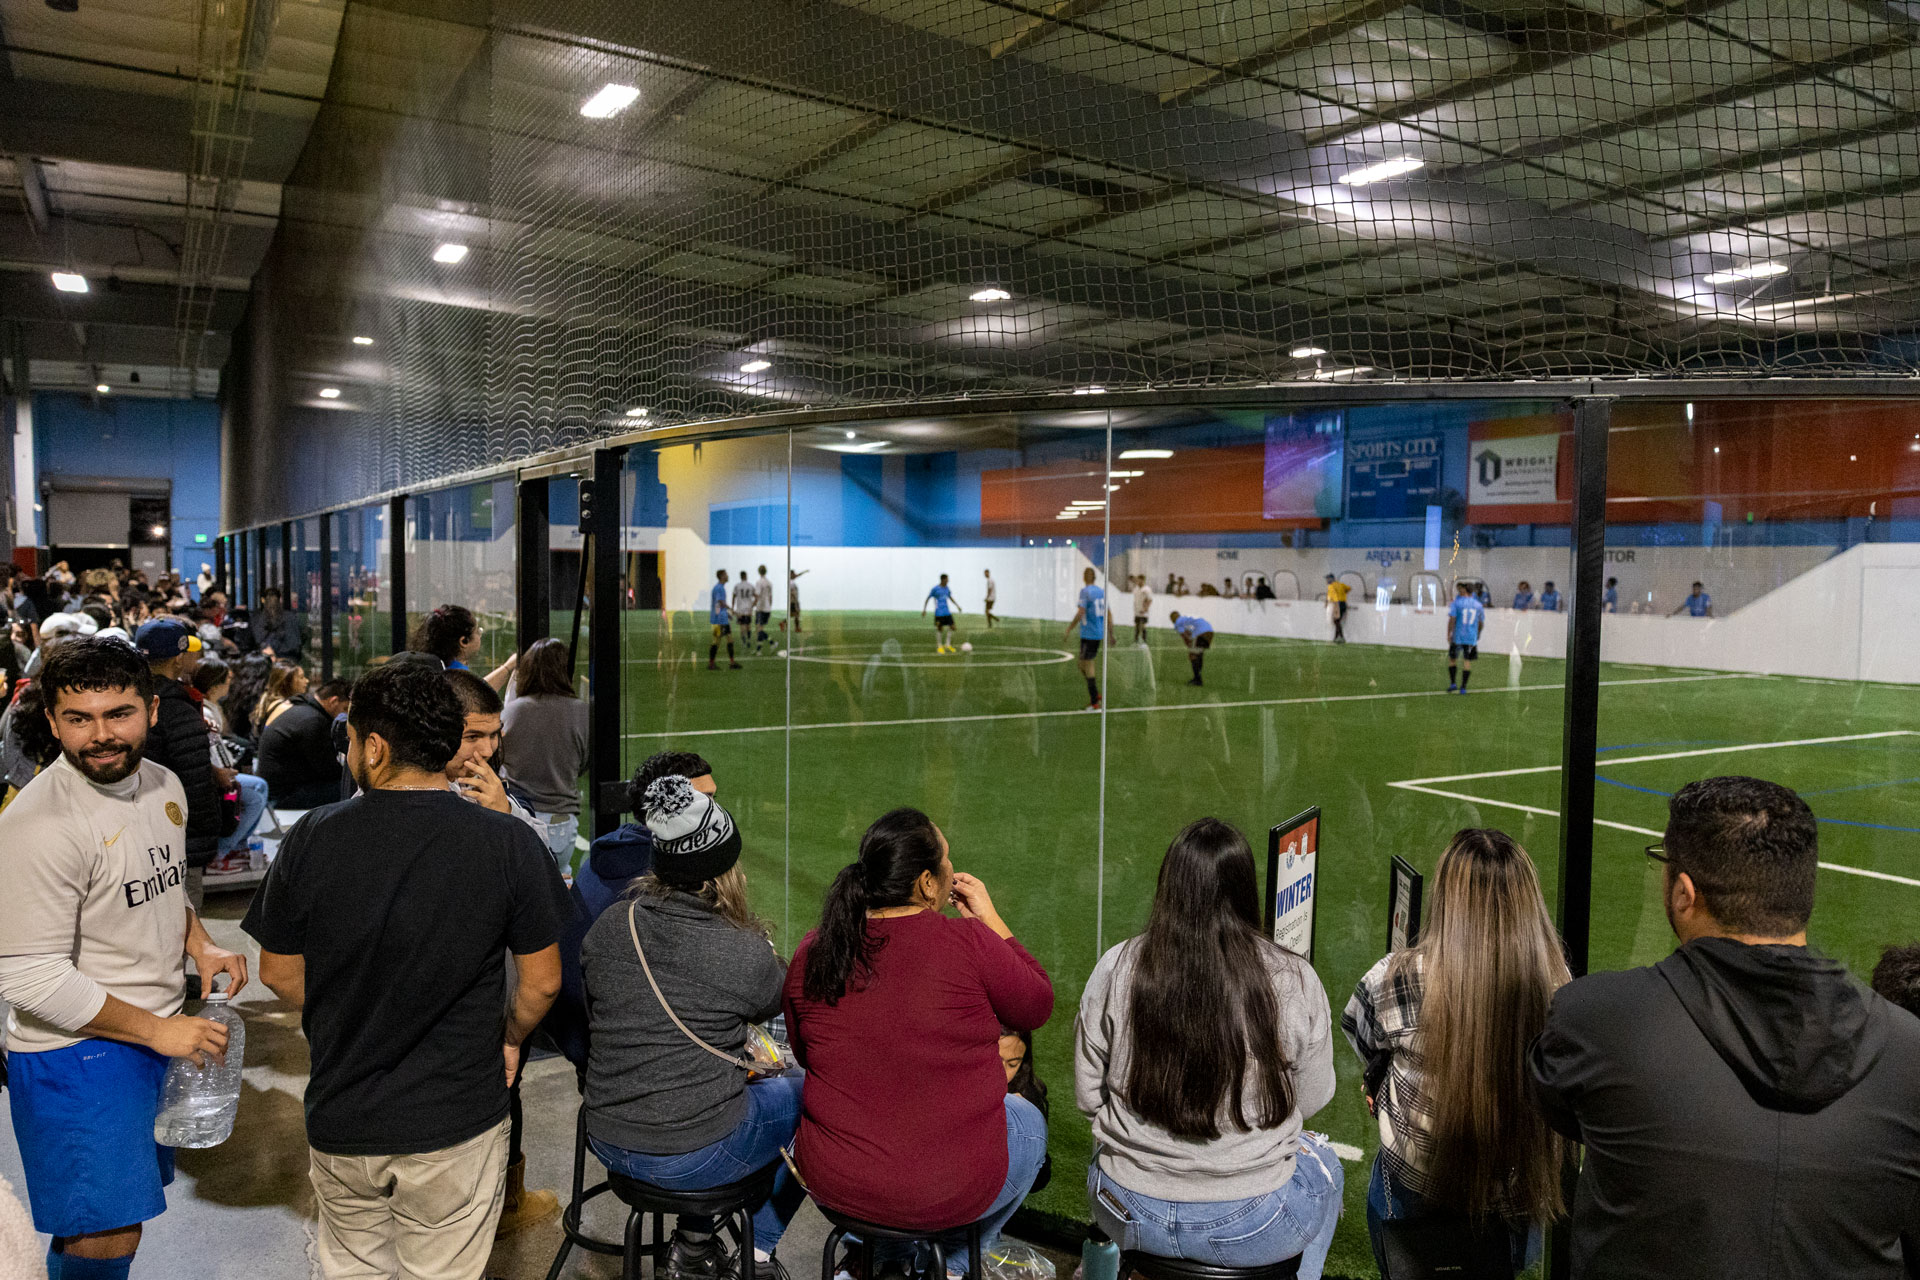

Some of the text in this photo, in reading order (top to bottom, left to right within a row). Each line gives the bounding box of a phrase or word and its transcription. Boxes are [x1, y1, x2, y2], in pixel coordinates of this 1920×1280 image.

[1348, 437, 1439, 458] SPORTS CITY
[1504, 455, 1554, 468] WRIGHT
[1366, 550, 1411, 561] ARENA 2
[1604, 549, 1636, 562] ITOR
[1462, 607, 1477, 625] 17
[1276, 872, 1312, 919] WINTER
[1275, 915, 1303, 942] Registration
